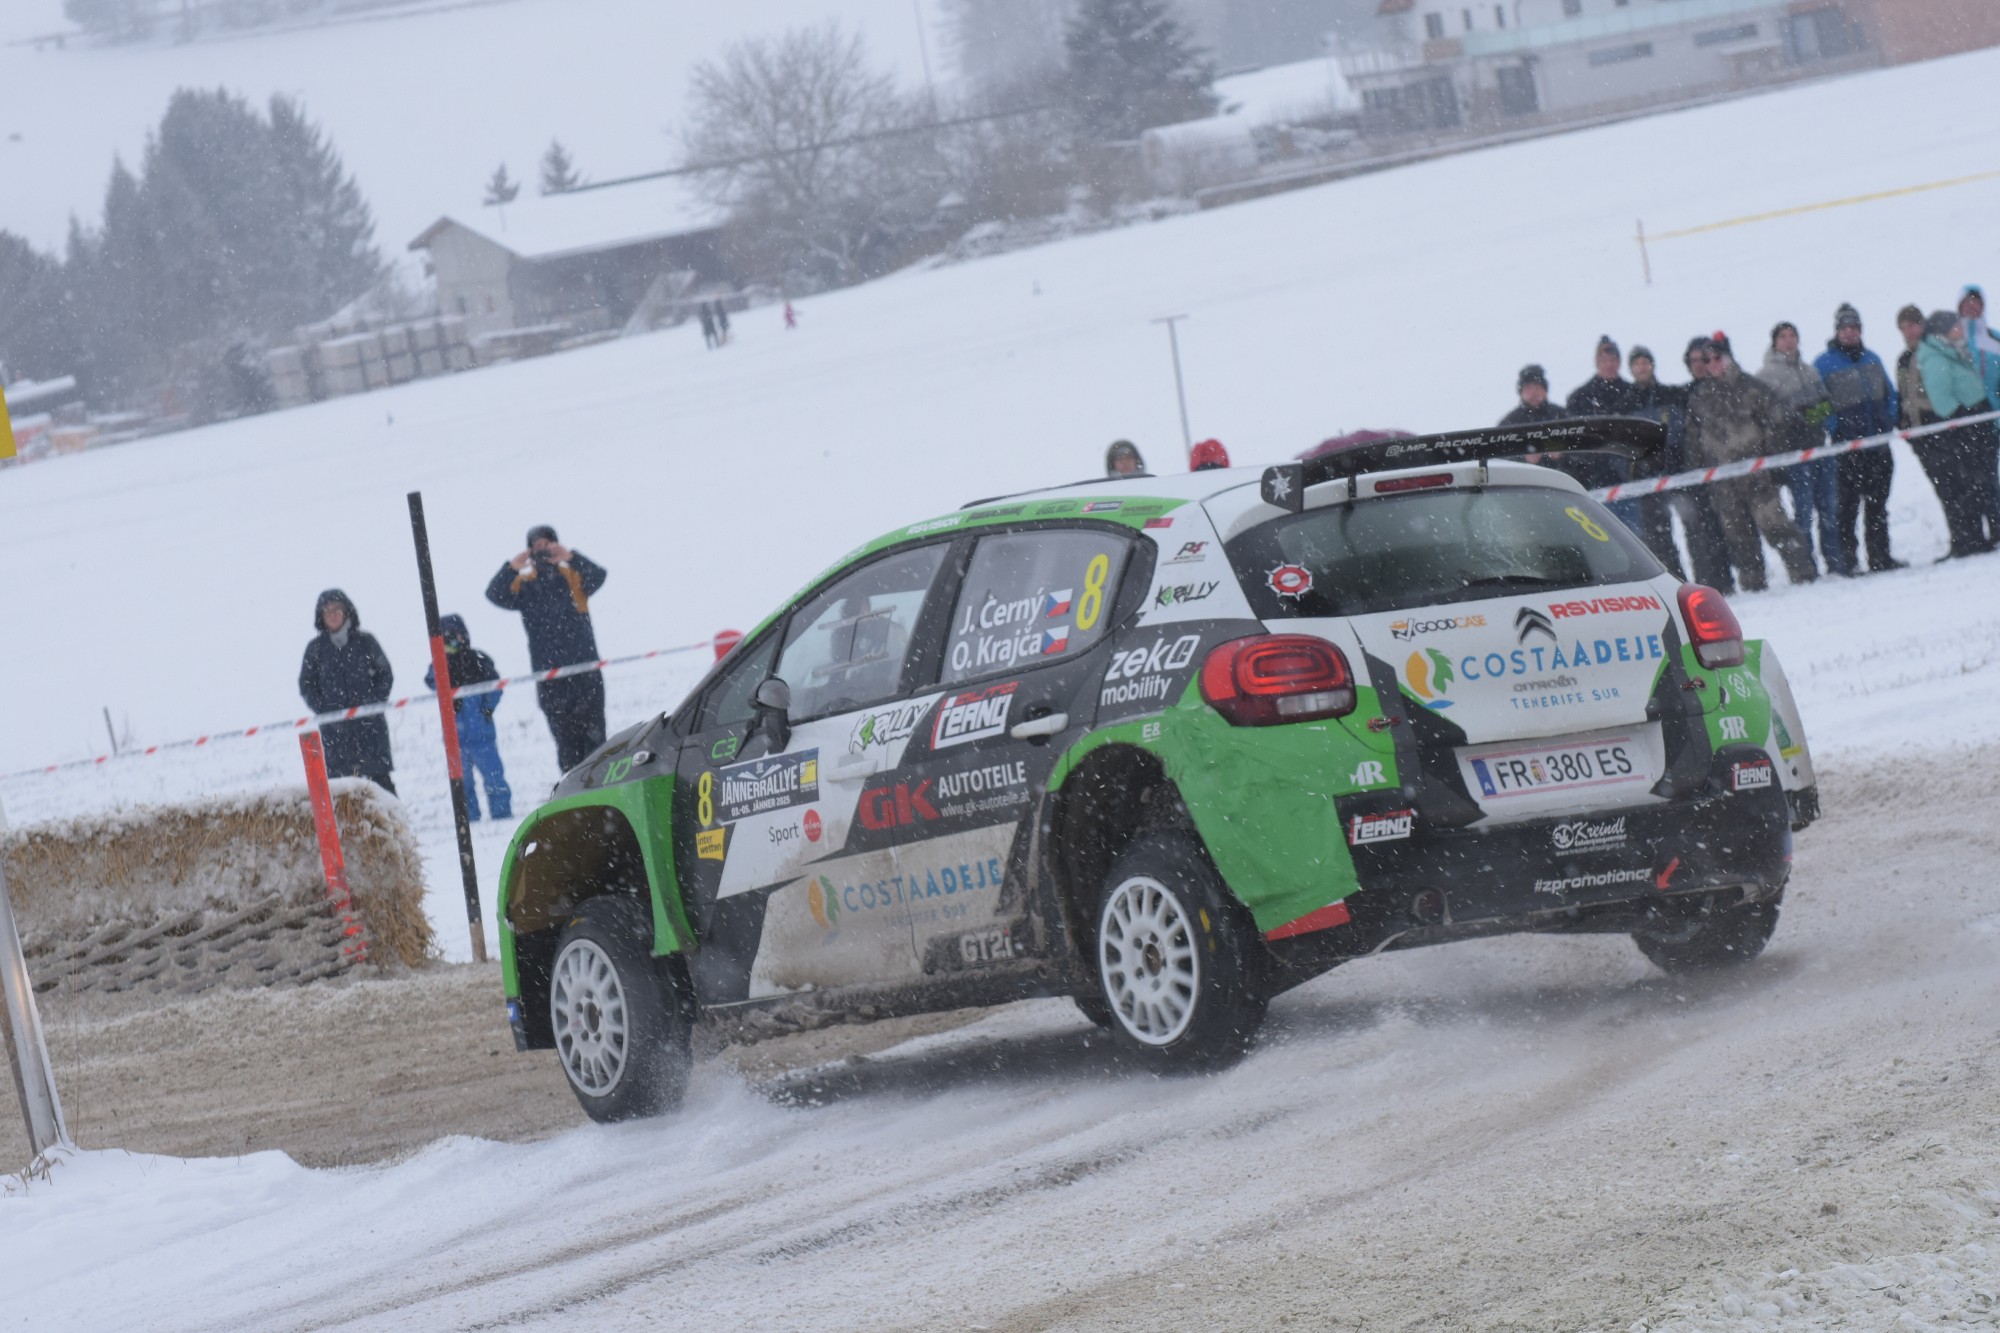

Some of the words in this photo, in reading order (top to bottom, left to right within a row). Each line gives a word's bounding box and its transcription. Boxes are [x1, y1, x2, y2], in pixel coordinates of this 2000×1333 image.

[1564, 507, 1609, 542] 8
[1076, 553, 1109, 631] 8
[1548, 596, 1662, 619] RSVISION
[959, 605, 976, 636] J.
[979, 587, 1045, 630] Černý
[952, 641, 972, 671] O.
[976, 627, 1043, 667] Krajča
[1101, 674, 1173, 706] mobility
[1511, 692, 1585, 709] TENERIFE
[1592, 687, 1621, 701] SUR
[711, 736, 738, 759] C3
[721, 764, 799, 806] JÄNNERRALLYE
[938, 761, 1027, 798] AUTOTEILE
[1484, 782, 1493, 792] A
[1495, 760, 1533, 789] FR
[1546, 752, 1593, 783] 380
[1595, 747, 1632, 776] ES
[698, 771, 713, 827] 8
[752, 797, 776, 812] JÄNNER
[776, 795, 791, 808] 2025
[858, 777, 940, 831] GK
[941, 788, 1031, 818] www.gk-autoteile.at
[698, 834, 713, 845] inter
[769, 822, 800, 846] Sport
[1572, 816, 1626, 840] Kreindl
[700, 842, 722, 855] wetten
